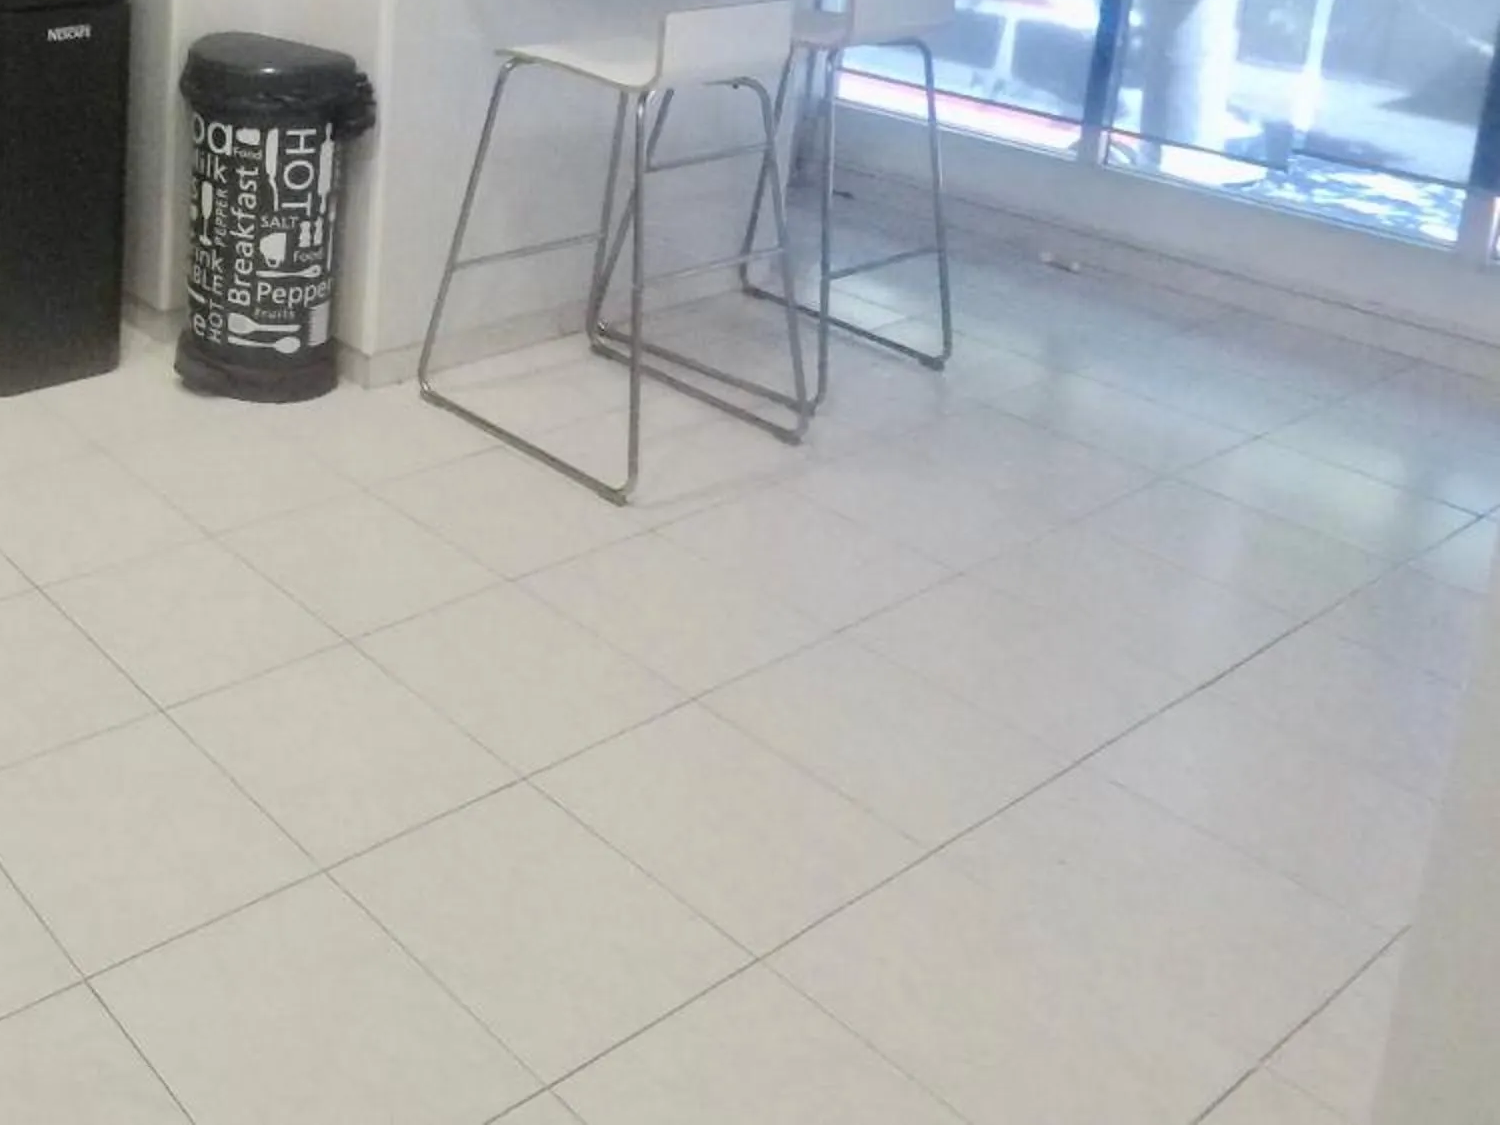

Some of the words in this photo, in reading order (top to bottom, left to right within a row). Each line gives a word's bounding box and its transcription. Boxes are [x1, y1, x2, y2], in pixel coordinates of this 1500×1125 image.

[281, 129, 317, 216] HOT
[228, 166, 259, 306] Breakfast
[260, 215, 300, 229] SALT
[293, 247, 323, 263] Food
[207, 299, 224, 344] HOT
